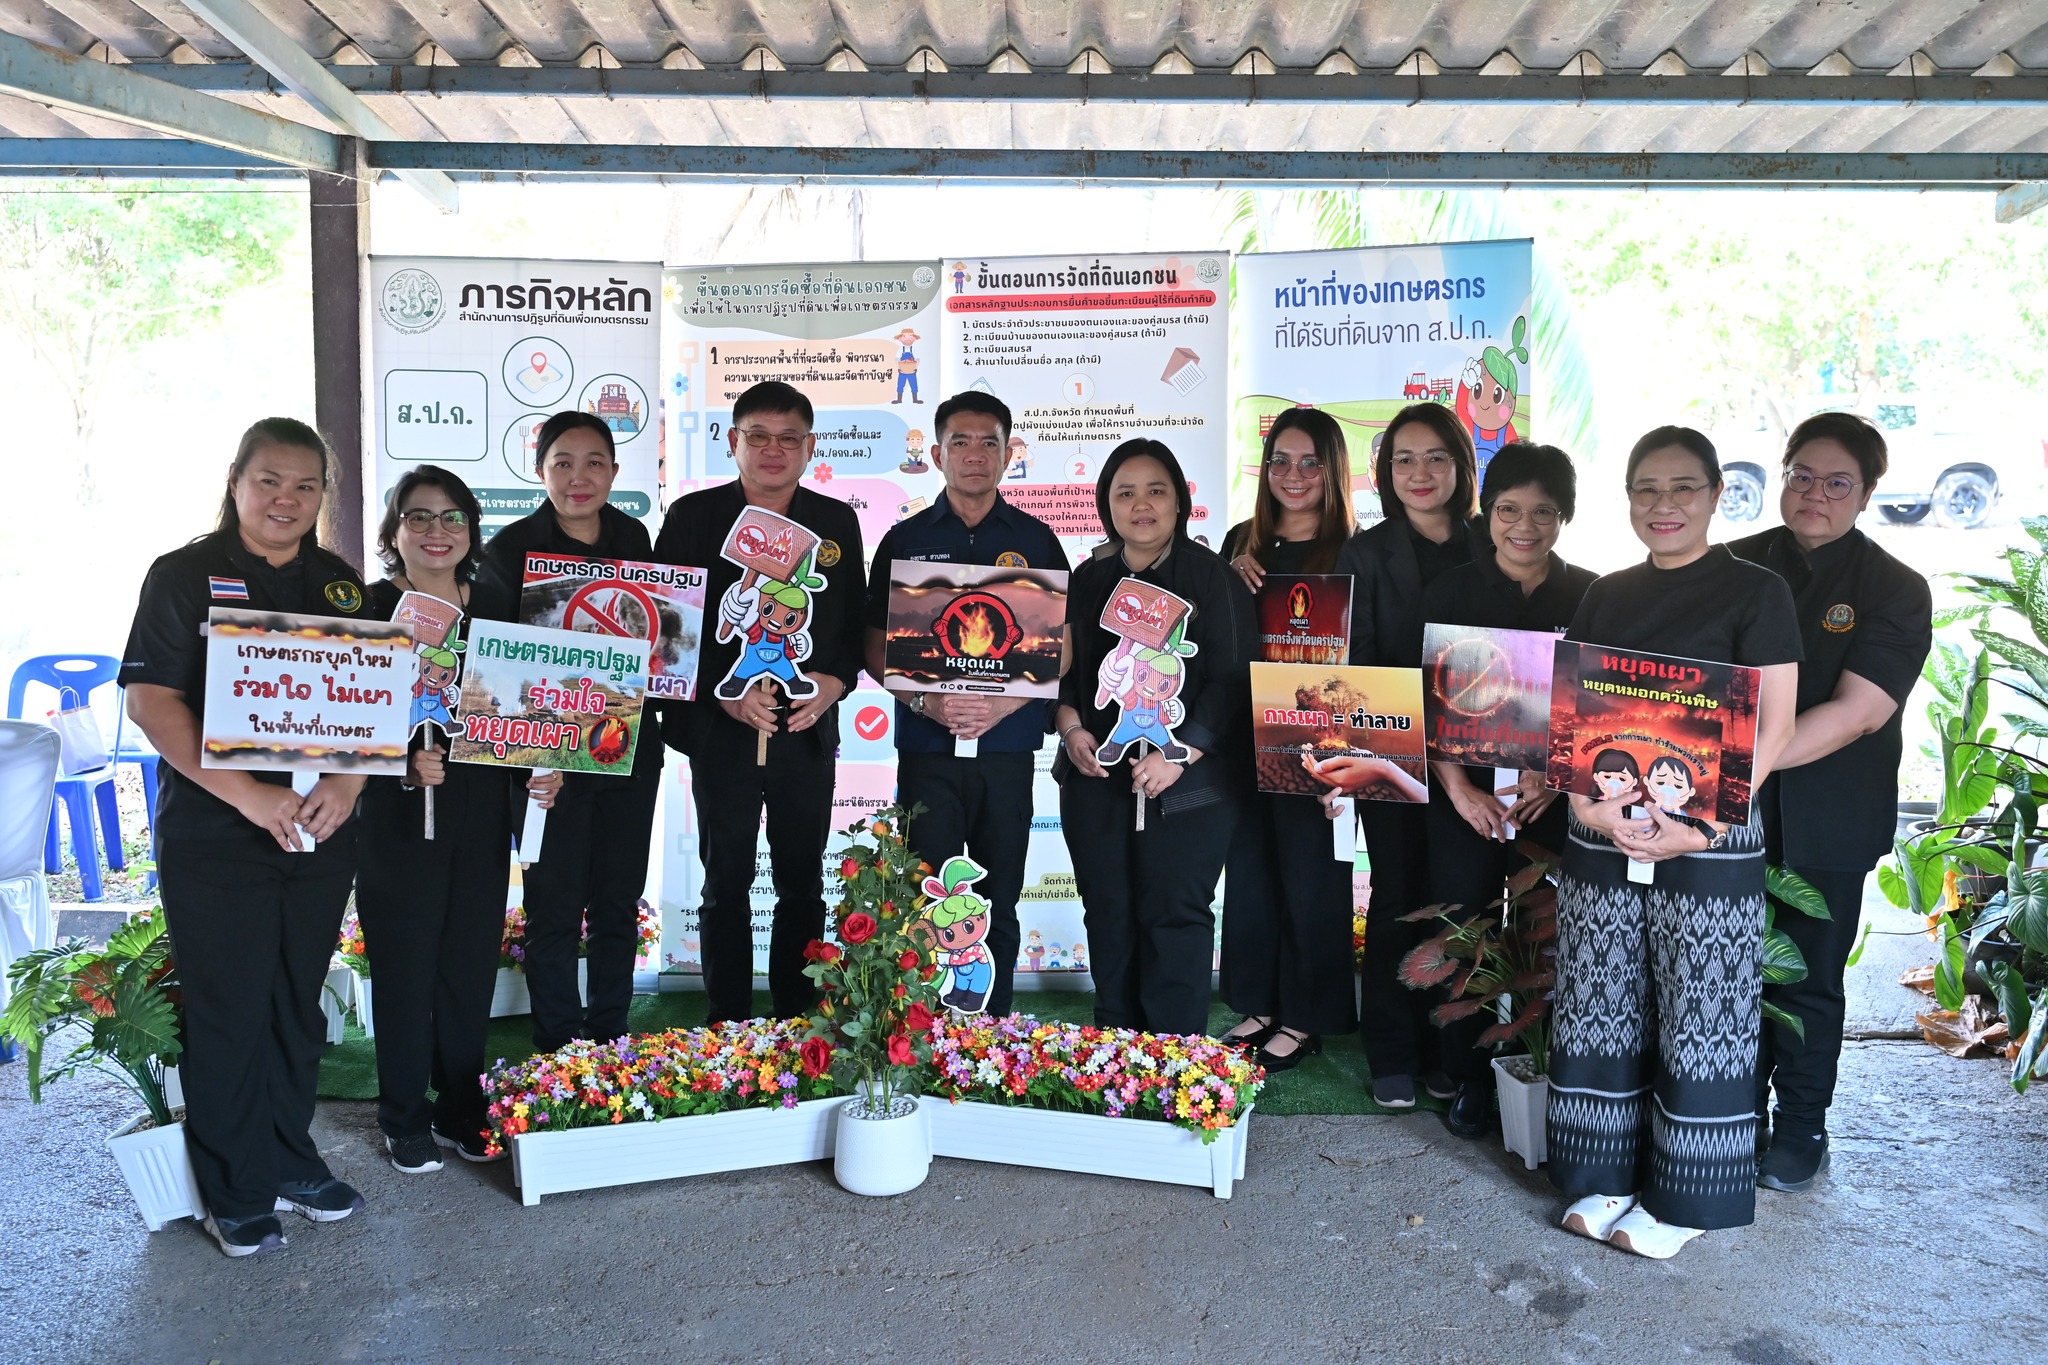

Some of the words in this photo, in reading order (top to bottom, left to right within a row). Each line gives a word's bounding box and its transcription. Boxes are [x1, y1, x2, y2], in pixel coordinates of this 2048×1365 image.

[696, 273, 908, 298] ขั้นตอนการจัดซื้อที่ดินเอกชน
[977, 259, 1178, 290] ขั้นตอนการจัดที่ดินเอกชน
[459, 277, 651, 312] ภารกิจหลัก
[1275, 270, 1486, 308] หน้าที่ของเกษตรกร
[949, 294, 1213, 312] เอกสารหลักฐานประกอบการยื่นคำขอขึ้นทะเบียนผู้ไร้ที่ดินทำกิน
[963, 321, 970, 329] 1.
[1183, 315, 1210, 325] (ถ้ามี)
[1275, 314, 1420, 348] ที่ได้รับที่ดินจาก
[1428, 314, 1492, 341] ส.ป.ก.
[963, 334, 972, 342] 2.
[1141, 328, 1167, 338] (ถ้ามี)
[845, 352, 885, 363] พิจารณา
[963, 346, 972, 354] 3.
[974, 345, 1032, 354] ทะเบียนสมรส
[975, 355, 1053, 366] สำเนาใบเปลี่ยนชื่อ
[1054, 357, 1074, 366] สกุล
[1076, 355, 1102, 365] (ถ้ามี)
[1074, 382, 1083, 396] 1
[397, 401, 474, 425] ส.ป.ก.
[1024, 407, 1081, 417] ส.ป.ก.จังหวัด
[1083, 404, 1135, 416] กำหนดพื้นที่
[1085, 415, 1204, 428] เพื่อให้ทราบจำนวนที่จะนำจัด
[709, 422, 720, 441] 2
[1038, 431, 1122, 442] ที่ดินให้แก่เกษตรกร
[1074, 462, 1086, 476] 2
[528, 557, 615, 579] เกษตรกร
[620, 567, 703, 590] นครปฐม
[237, 644, 393, 671] เกษตรกรยุคใหม่
[477, 636, 641, 681] เกษตรนครปฐม
[945, 656, 1004, 671] หยุดเผา
[1602, 655, 1701, 682] หยุดเผา
[233, 666, 312, 701] ร่วมใจ
[322, 673, 392, 706] ไม่เผา
[529, 677, 605, 714] ร่วมใจ
[1583, 679, 1719, 710] หยุดหมอกควันพิษ
[249, 712, 375, 739] ในพื้นที่เกษตร
[1264, 708, 1328, 726] การเผา
[1350, 708, 1411, 730] ทำลาย
[466, 714, 580, 759] หยุดเผา
